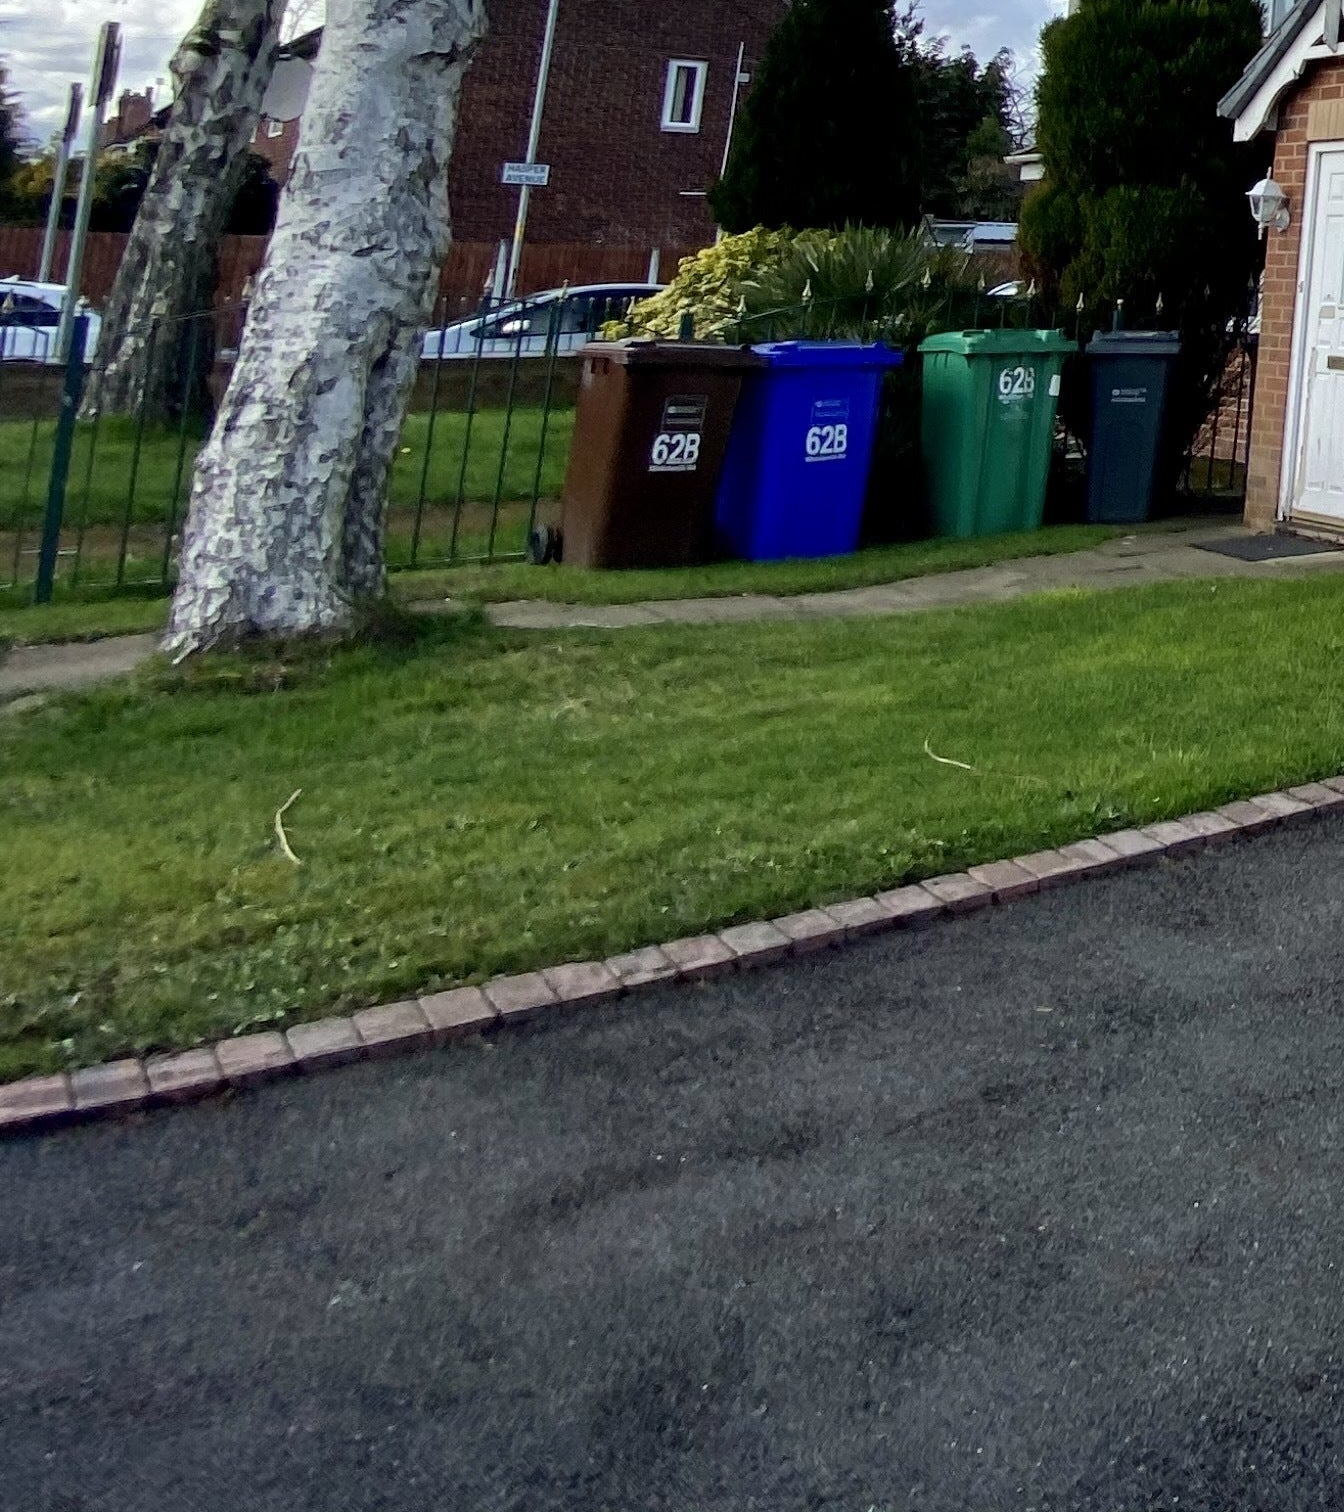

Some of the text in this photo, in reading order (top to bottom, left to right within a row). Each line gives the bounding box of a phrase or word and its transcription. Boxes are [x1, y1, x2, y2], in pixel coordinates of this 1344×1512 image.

[505, 174, 546, 183] AVENUE
[999, 366, 1035, 394] 62B
[651, 433, 701, 465] 62B
[805, 424, 848, 456] 62B
